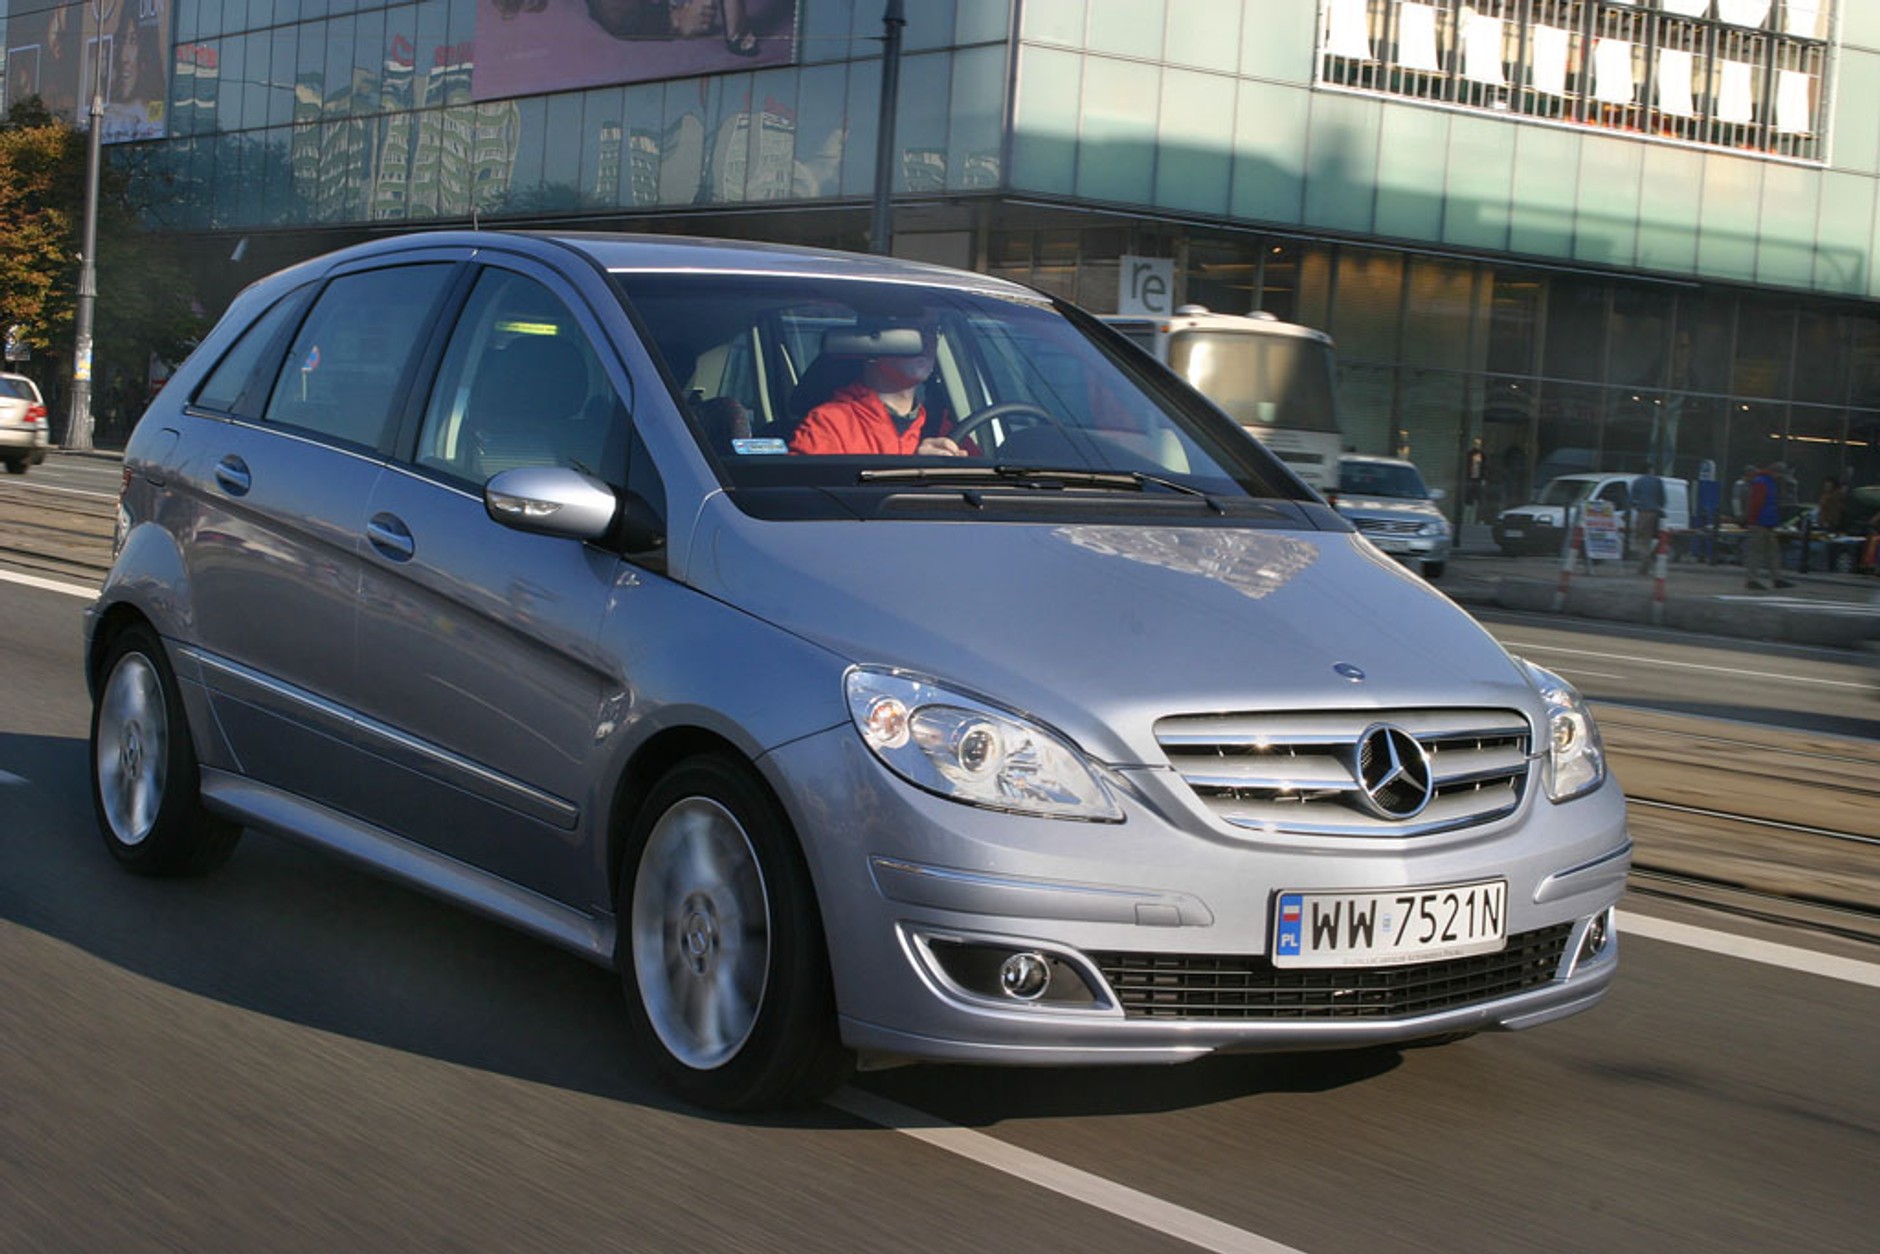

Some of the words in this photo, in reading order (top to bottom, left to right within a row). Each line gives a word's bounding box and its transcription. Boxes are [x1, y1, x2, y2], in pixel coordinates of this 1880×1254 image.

[1131, 261, 1167, 313] re
[1280, 932, 1299, 948] PL
[1312, 899, 1377, 950] WW
[1393, 886, 1501, 947] 7521N
